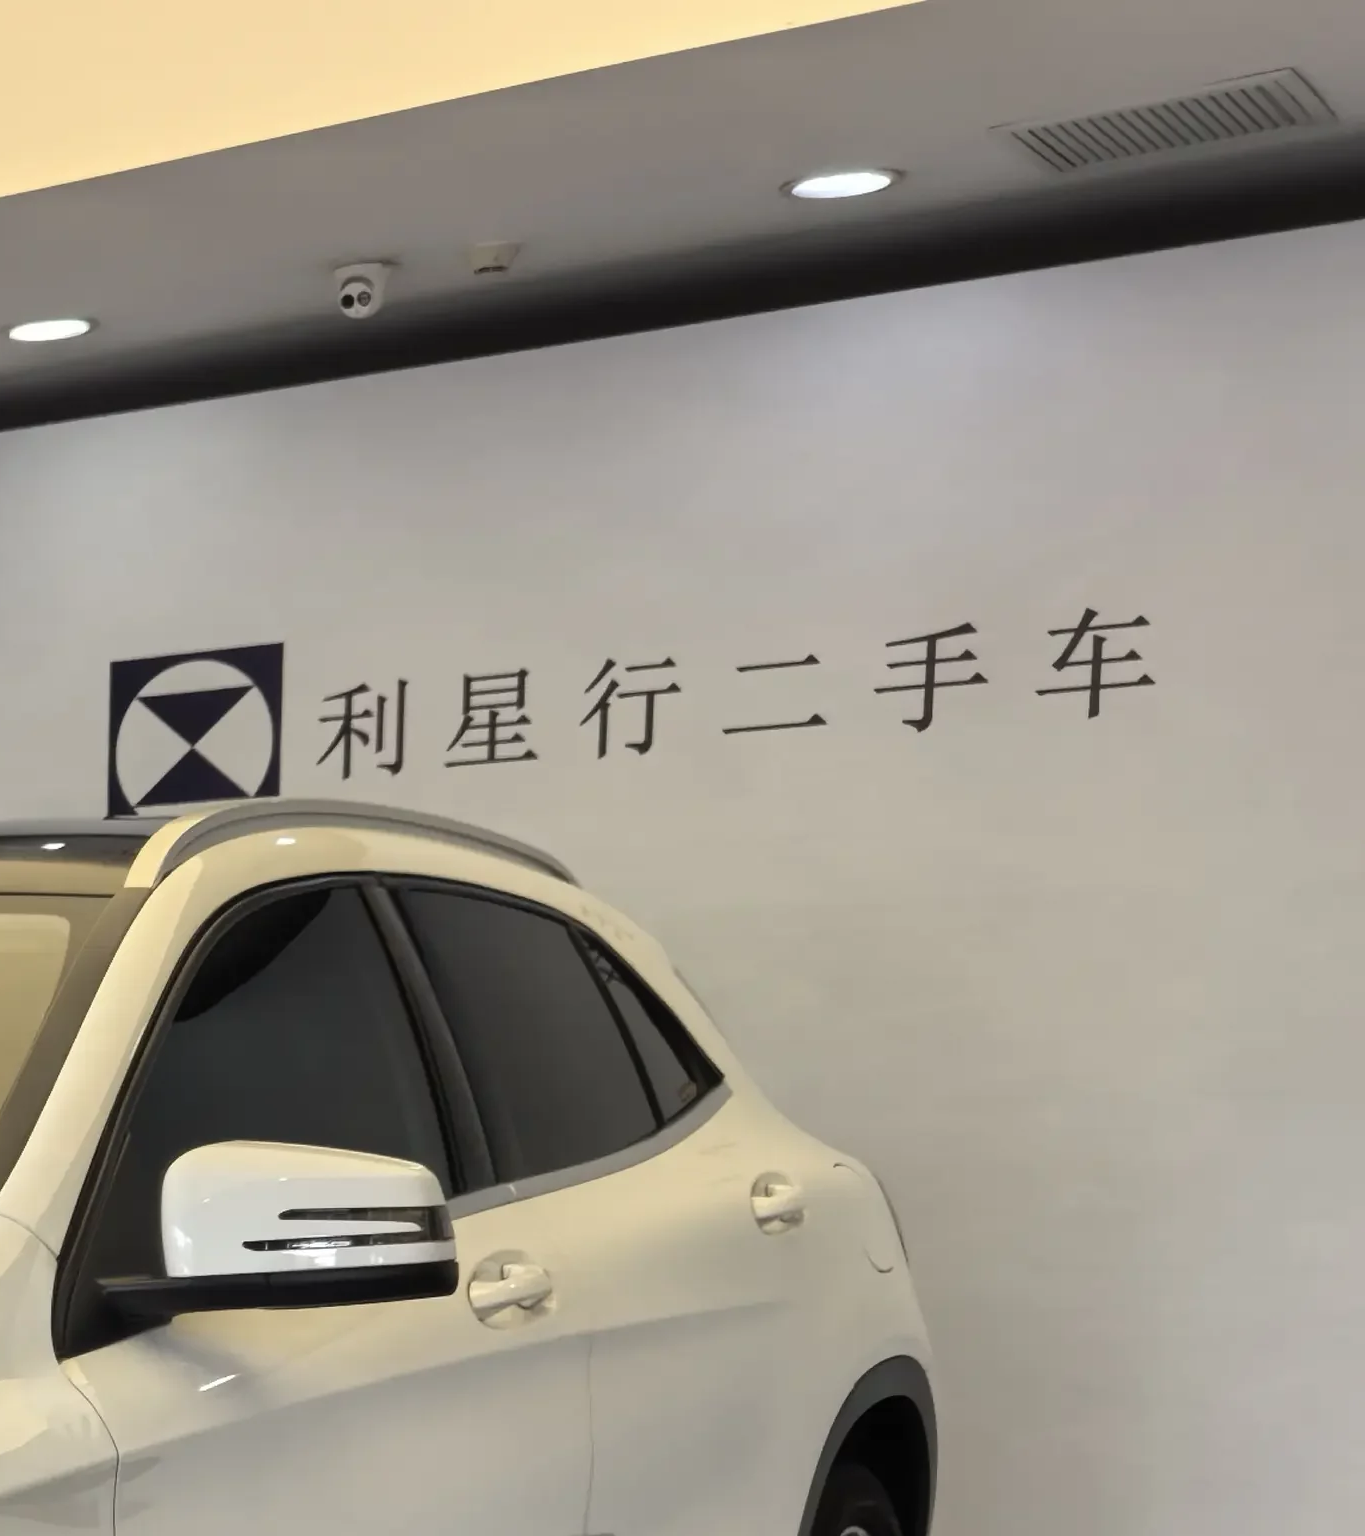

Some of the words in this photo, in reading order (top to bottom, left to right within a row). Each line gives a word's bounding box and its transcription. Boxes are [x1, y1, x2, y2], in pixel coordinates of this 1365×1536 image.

[315, 607, 1157, 781] 利星行二手车
